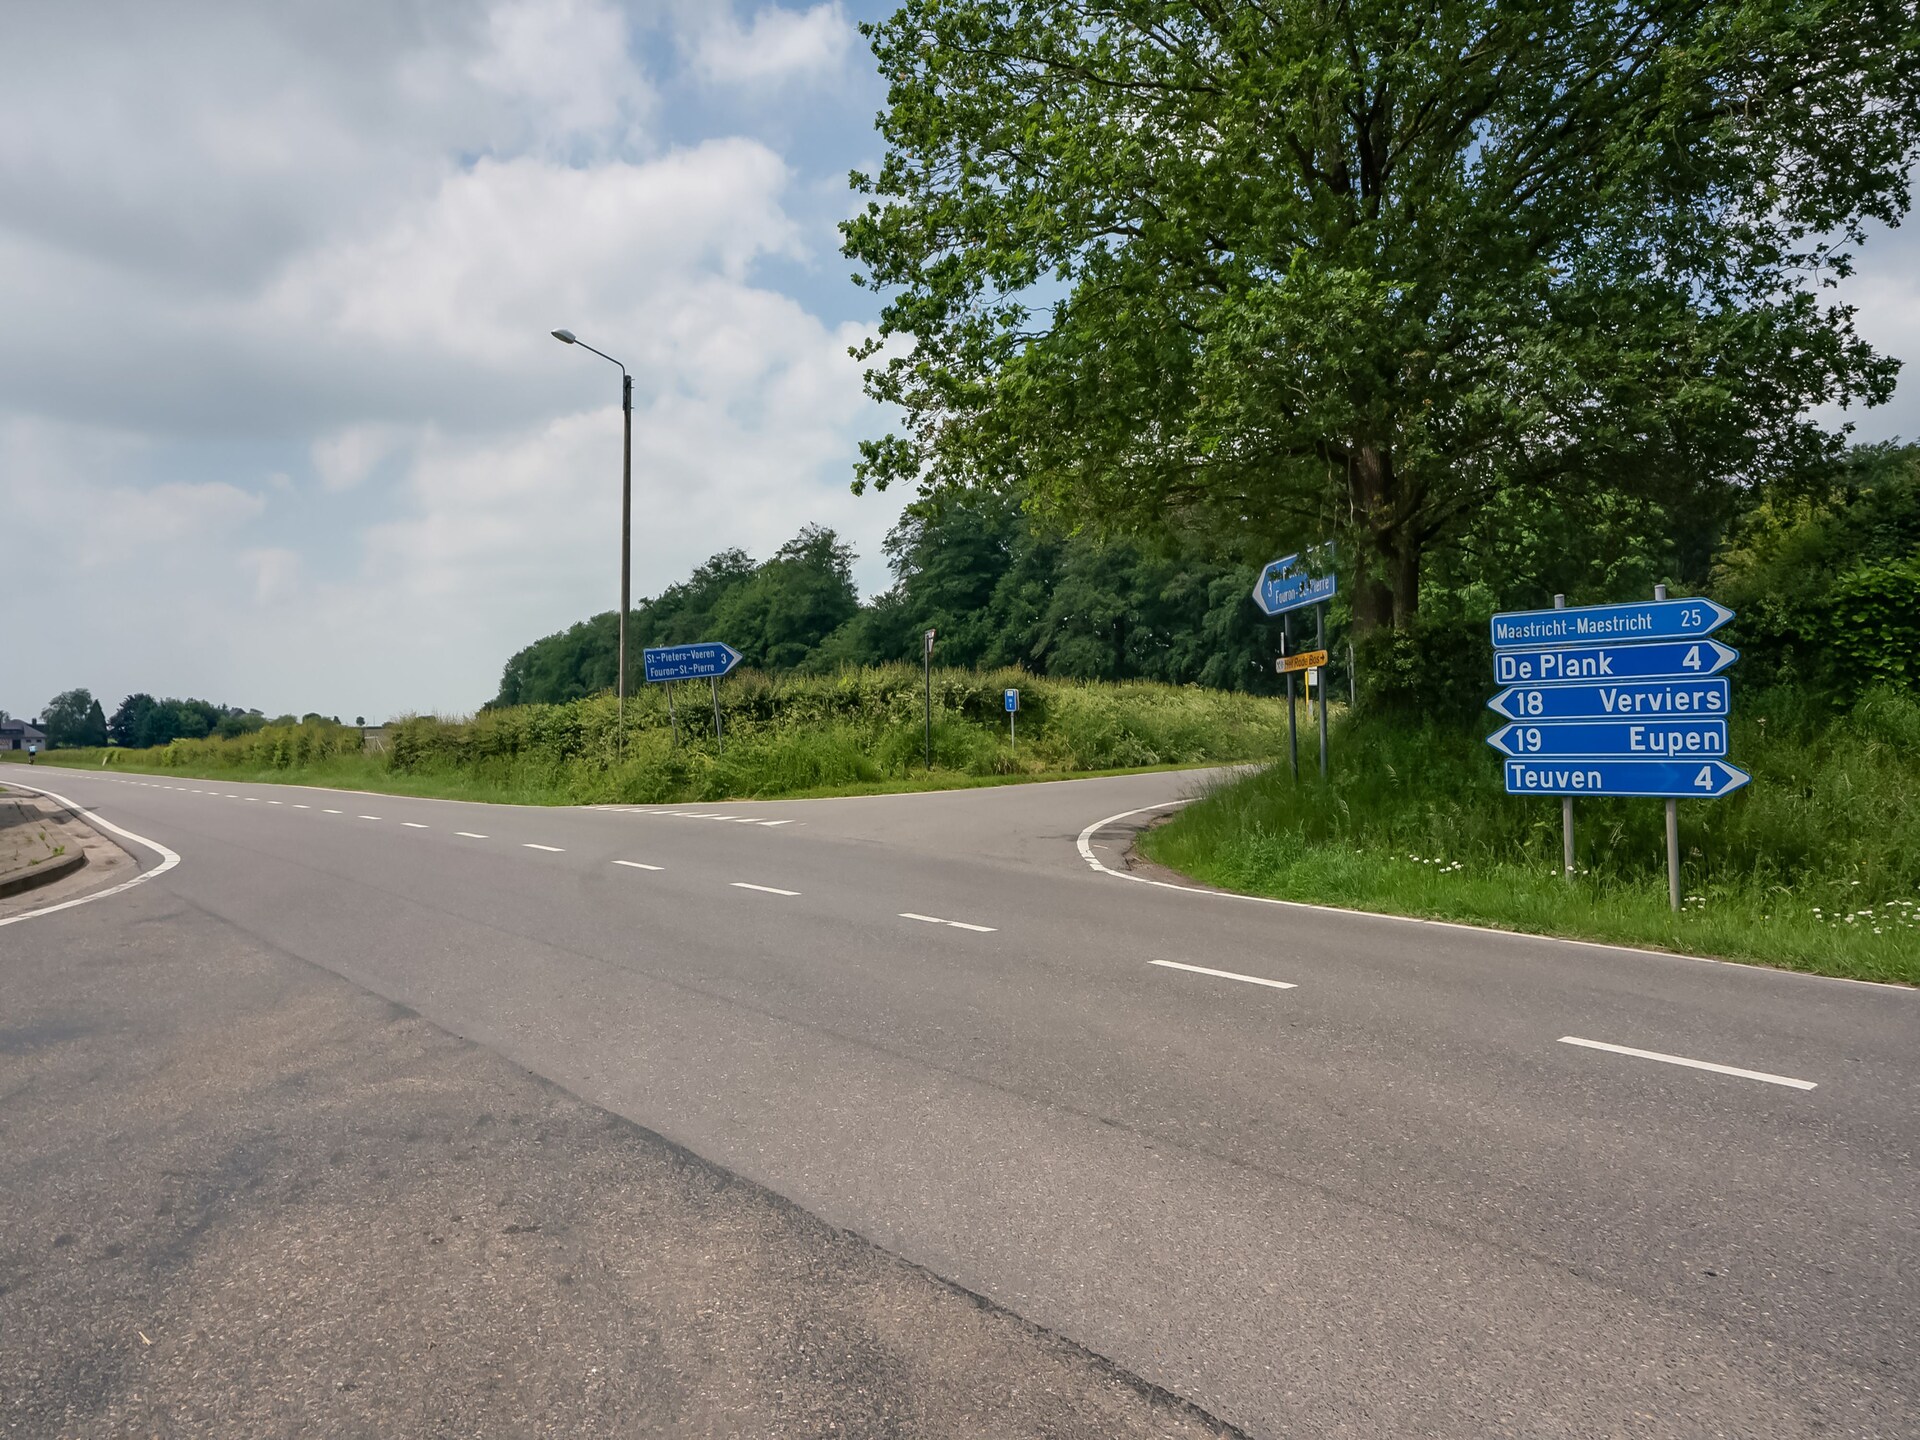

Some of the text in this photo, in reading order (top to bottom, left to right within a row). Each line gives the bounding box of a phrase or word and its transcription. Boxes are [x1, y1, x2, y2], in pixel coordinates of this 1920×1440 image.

[1497, 609, 1702, 639] Maastricht-Maestricht 25
[720, 653, 727, 665] 3
[1501, 645, 1702, 680] De Plank 4
[1517, 687, 1722, 715] 18 Verviers
[1515, 726, 1720, 757] 19 Eupen
[1511, 765, 1713, 791] Teuven 4
